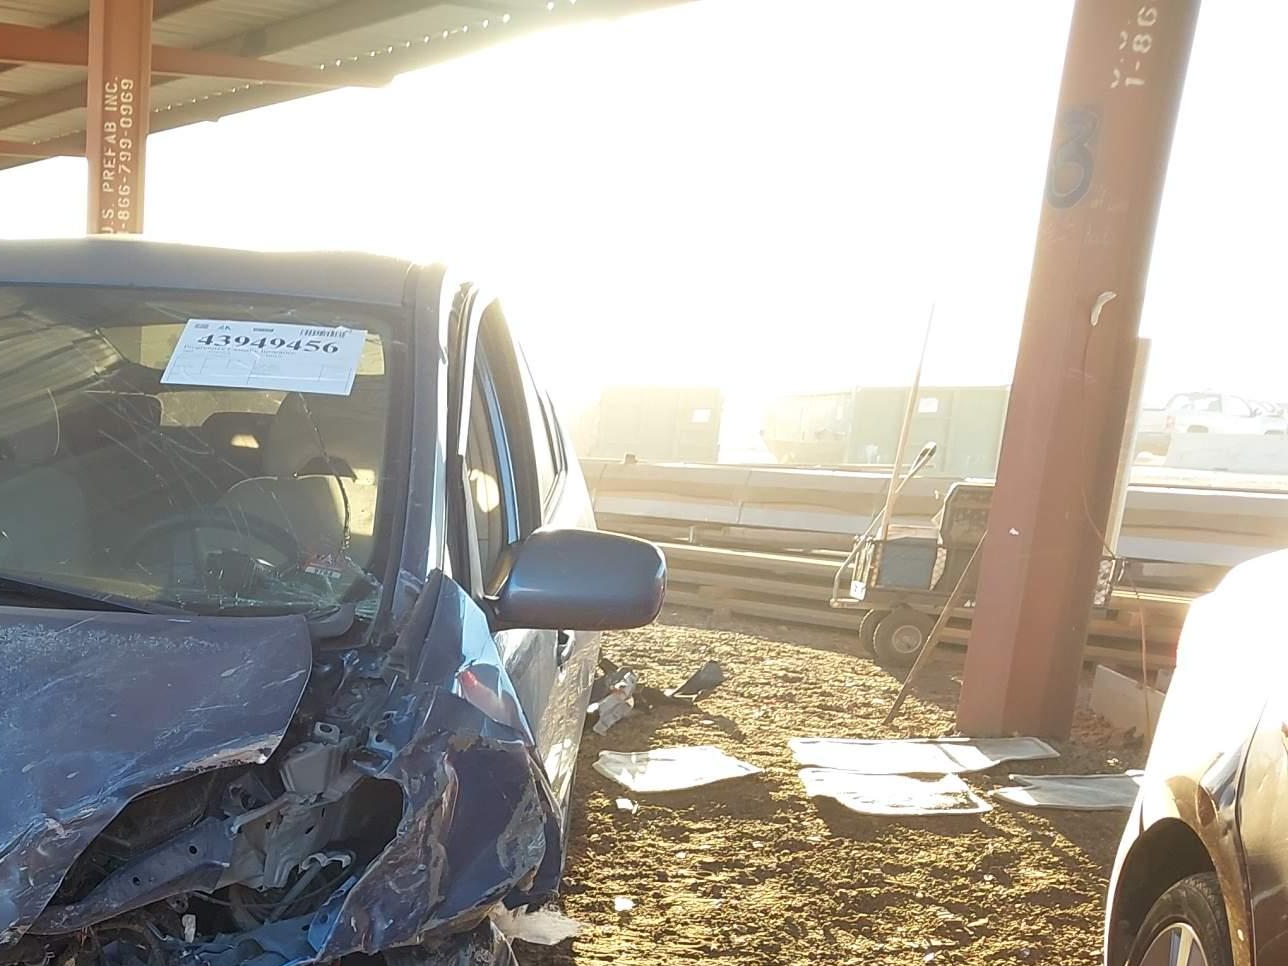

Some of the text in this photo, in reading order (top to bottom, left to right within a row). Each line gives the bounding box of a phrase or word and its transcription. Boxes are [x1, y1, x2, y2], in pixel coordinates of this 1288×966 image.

[105, 76, 119, 111] INC.
[103, 121, 116, 193] PREFAB
[197, 334, 339, 354] 43949456
